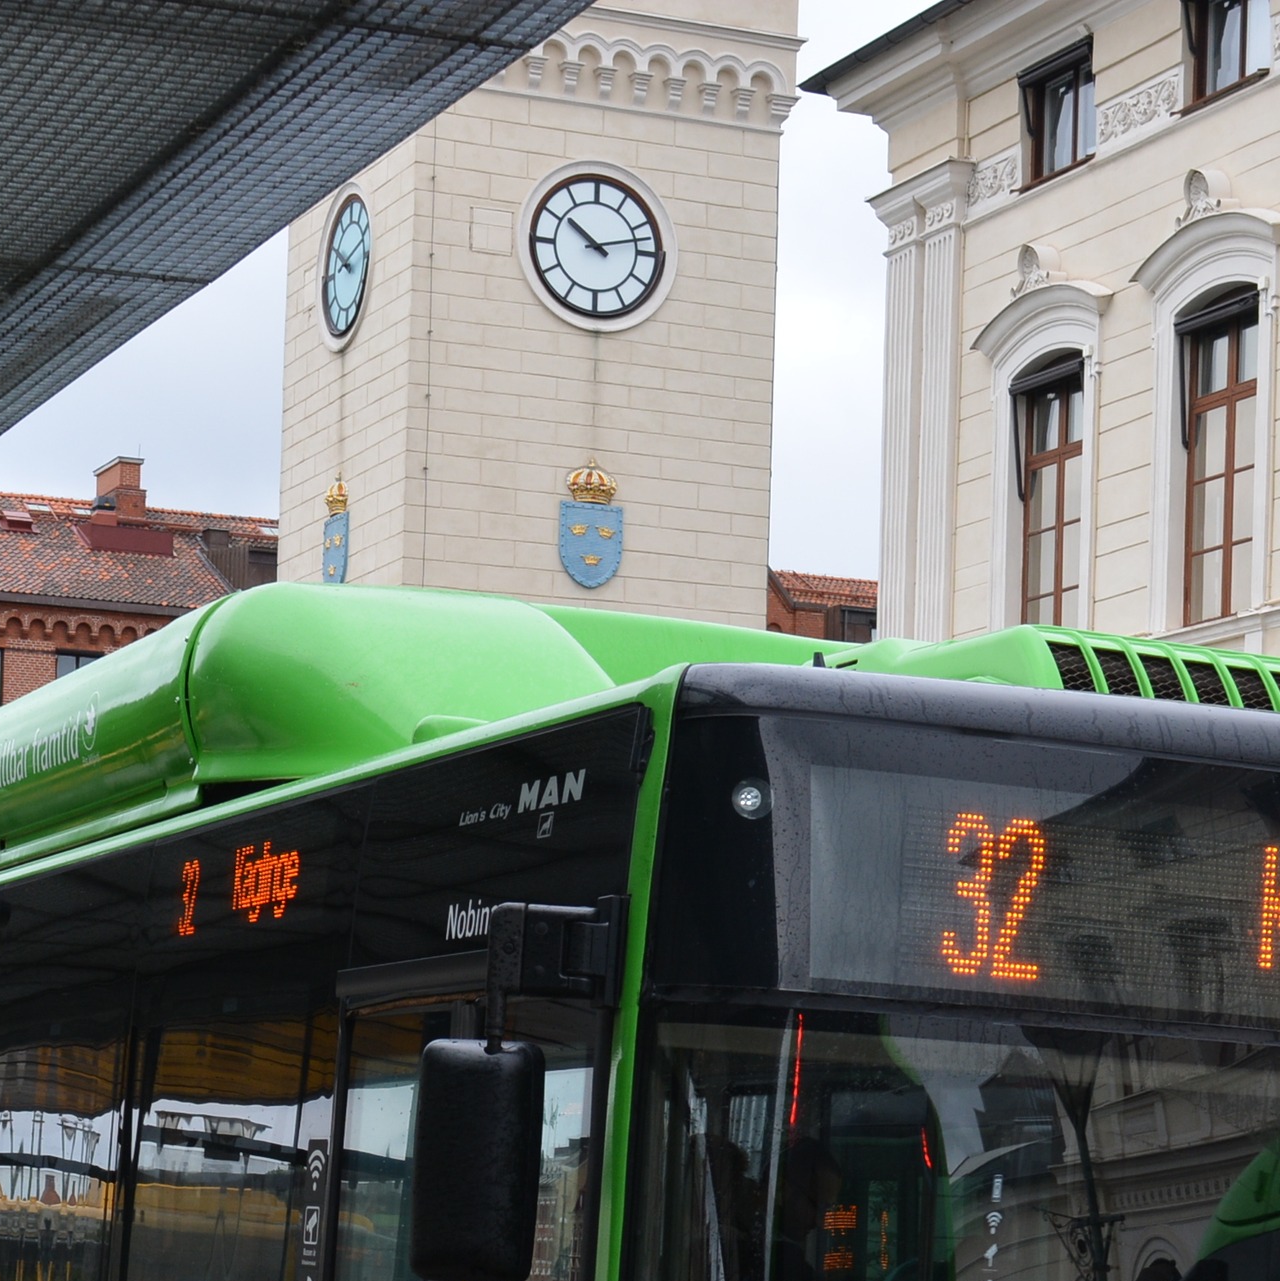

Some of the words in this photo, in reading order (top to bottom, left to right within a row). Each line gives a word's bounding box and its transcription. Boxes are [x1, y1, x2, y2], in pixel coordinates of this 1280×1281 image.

[32, 710, 81, 775] framtid
[458, 810, 487, 827] Lion's
[489, 802, 512, 820] City
[517, 768, 587, 814] MAN
[446, 899, 491, 941] Nobin
[941, 812, 1045, 982] 32
